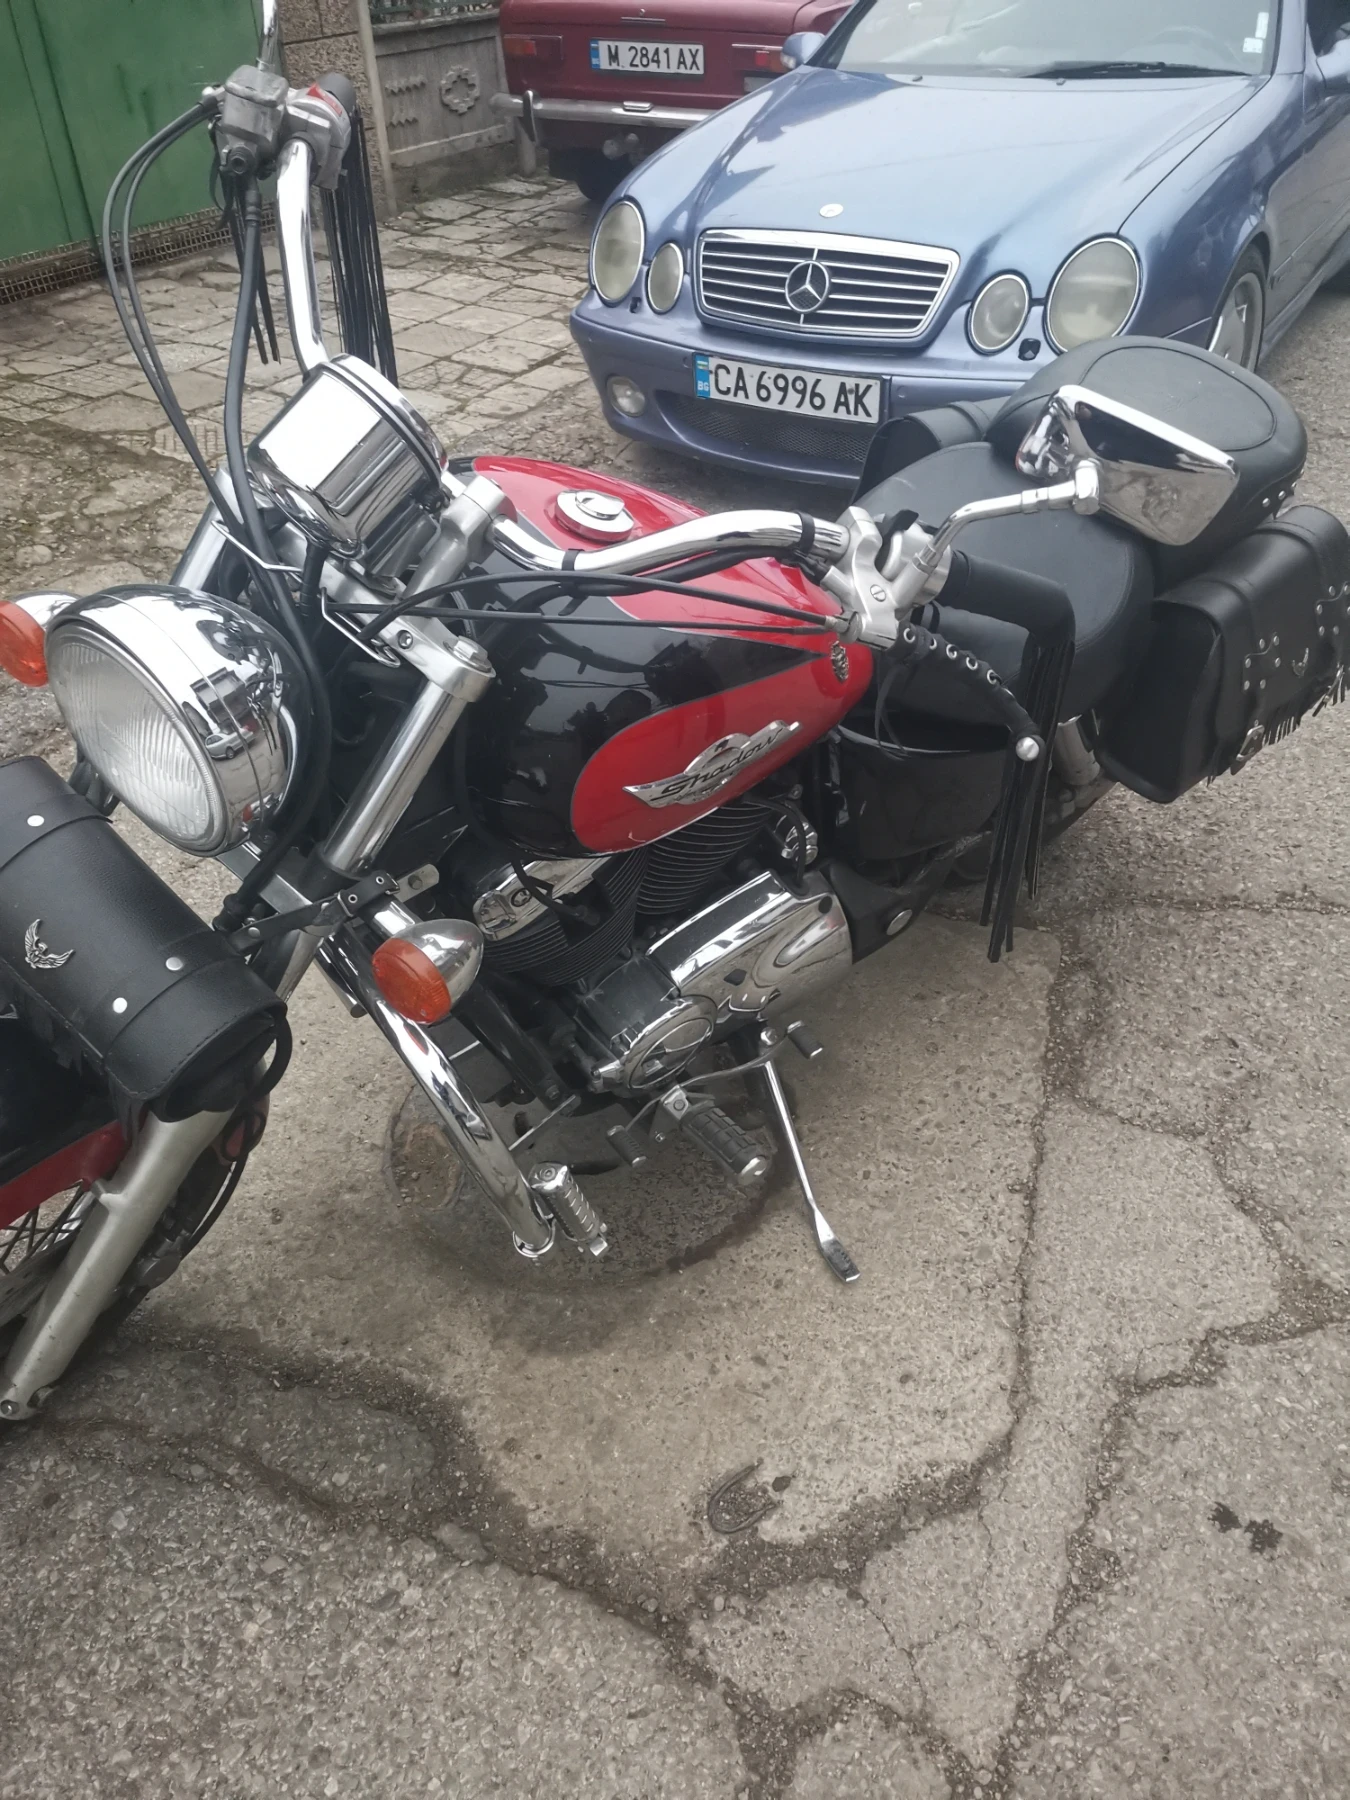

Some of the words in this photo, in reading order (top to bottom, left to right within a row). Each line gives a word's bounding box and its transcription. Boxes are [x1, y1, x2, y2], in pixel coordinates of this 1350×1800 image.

[607, 44, 620, 67] M
[628, 46, 671, 69] 2841
[677, 48, 701, 71] AX
[697, 379, 709, 392] BG
[714, 363, 750, 400] CA
[756, 371, 826, 411] 6996
[833, 381, 873, 418] AK
[650, 727, 784, 801] Shadow
